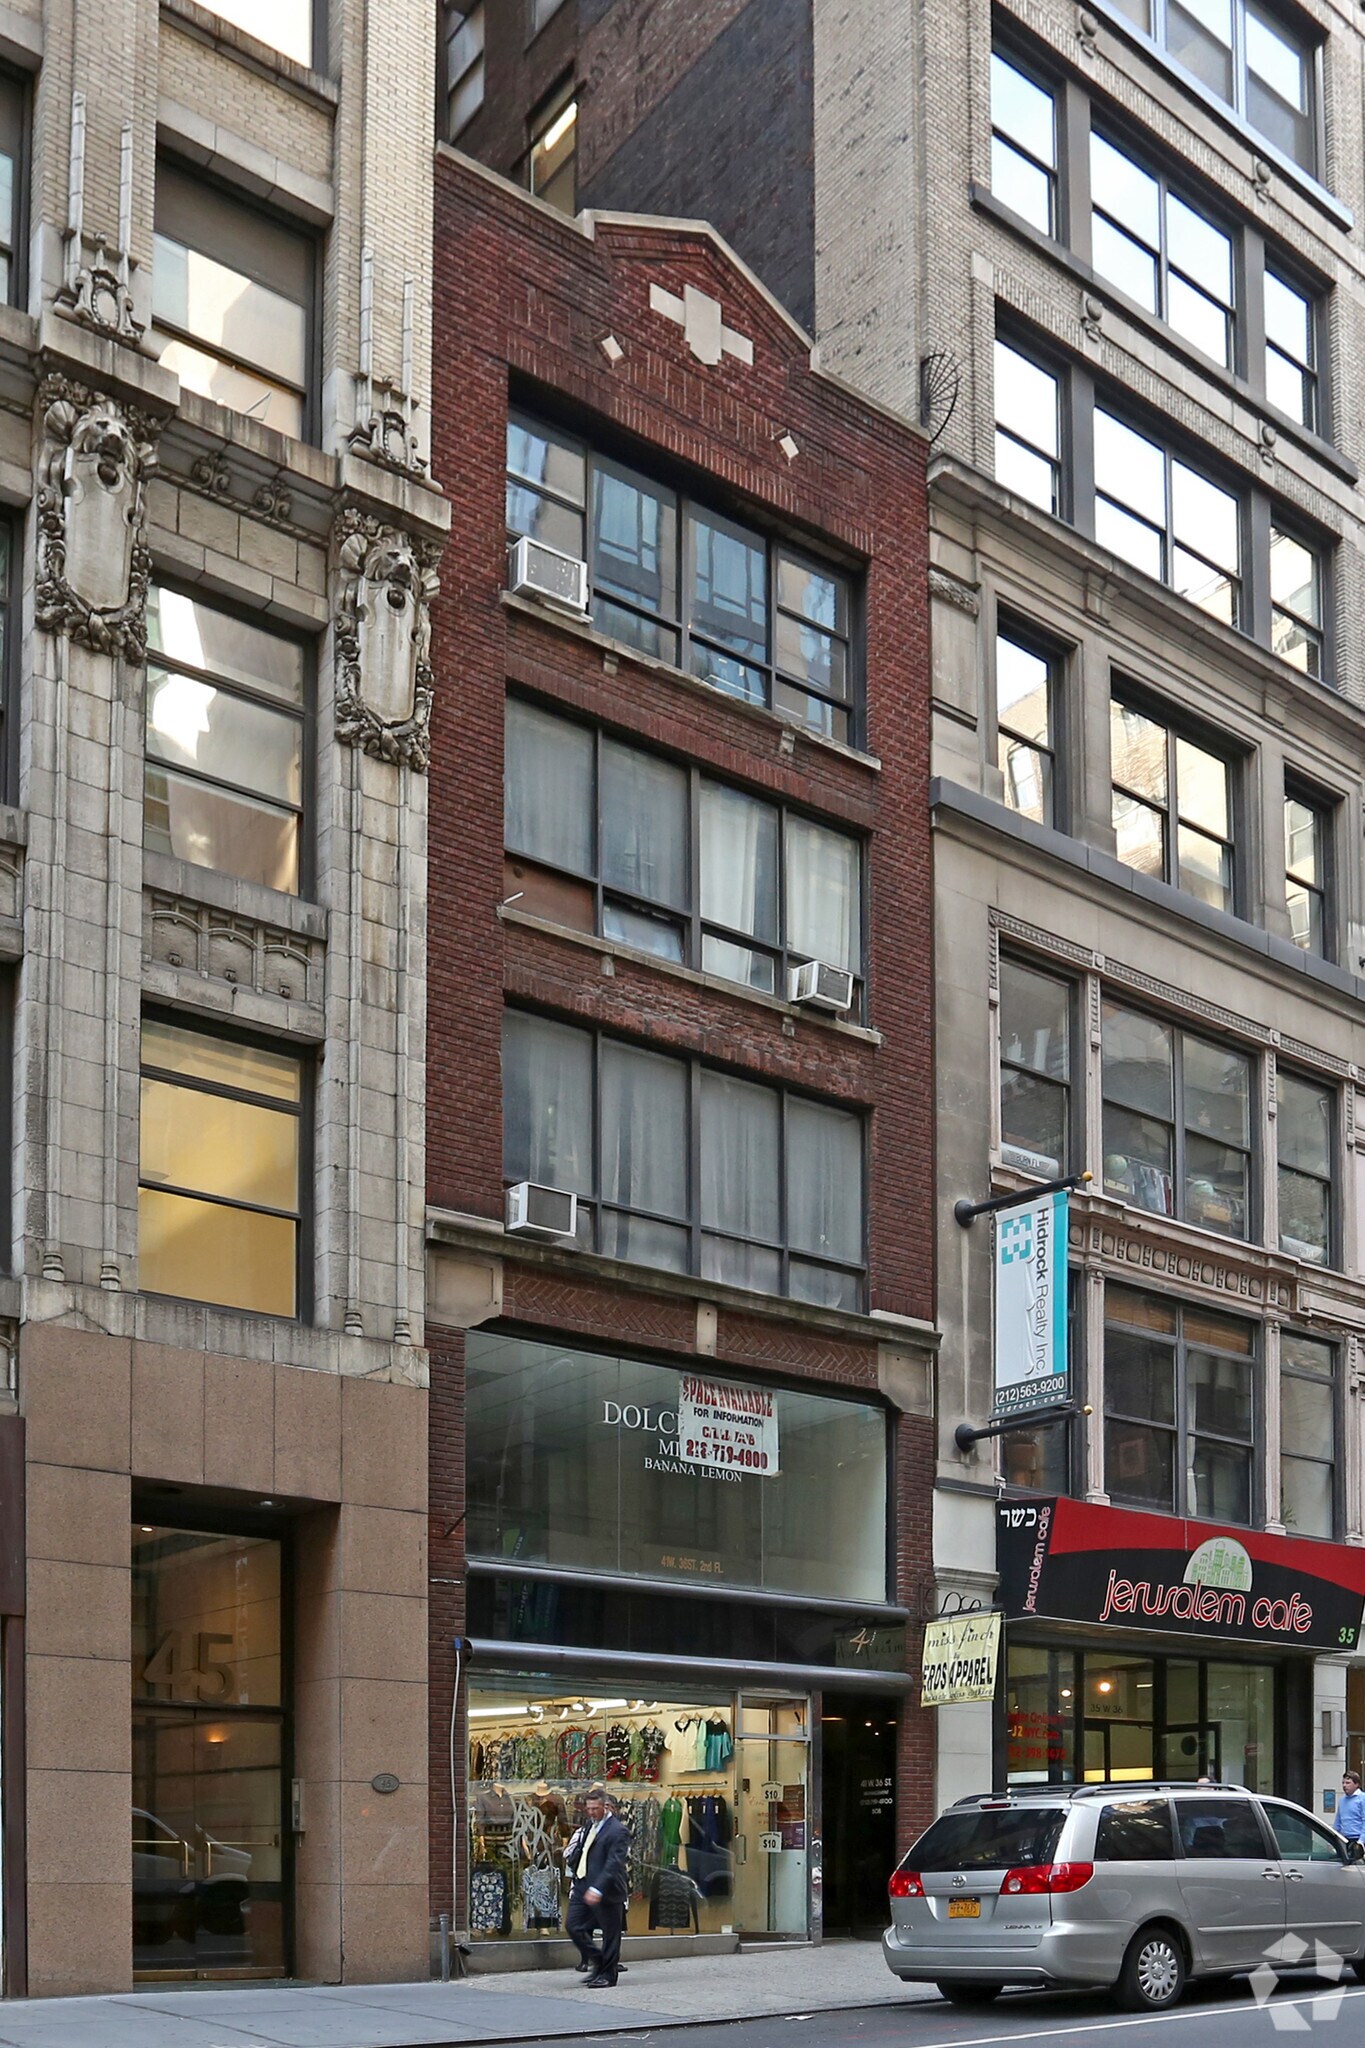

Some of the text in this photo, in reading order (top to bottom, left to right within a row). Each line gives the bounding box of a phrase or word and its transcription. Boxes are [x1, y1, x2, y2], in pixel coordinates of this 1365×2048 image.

[1034, 1208, 1049, 1375] Hidrock Realty Inc.
[683, 1375, 773, 1418] SPACE AVAILABLE
[693, 1407, 764, 1428] FOR INFORMATION
[644, 1458, 742, 1482] BANANA LEMON
[1000, 1507, 1048, 1528] כשר
[1037, 1506, 1051, 1541] cafe
[1251, 1592, 1313, 1633] cafe
[928, 1619, 994, 1650] miss finch
[1338, 1626, 1354, 1644] 35
[142, 1629, 235, 1703] 45
[923, 1656, 993, 1692] EROS APPAREL
[1090, 1704, 1123, 1714] 35 W 36
[764, 1790, 778, 1799] $10
[762, 1839, 776, 1849] $10
